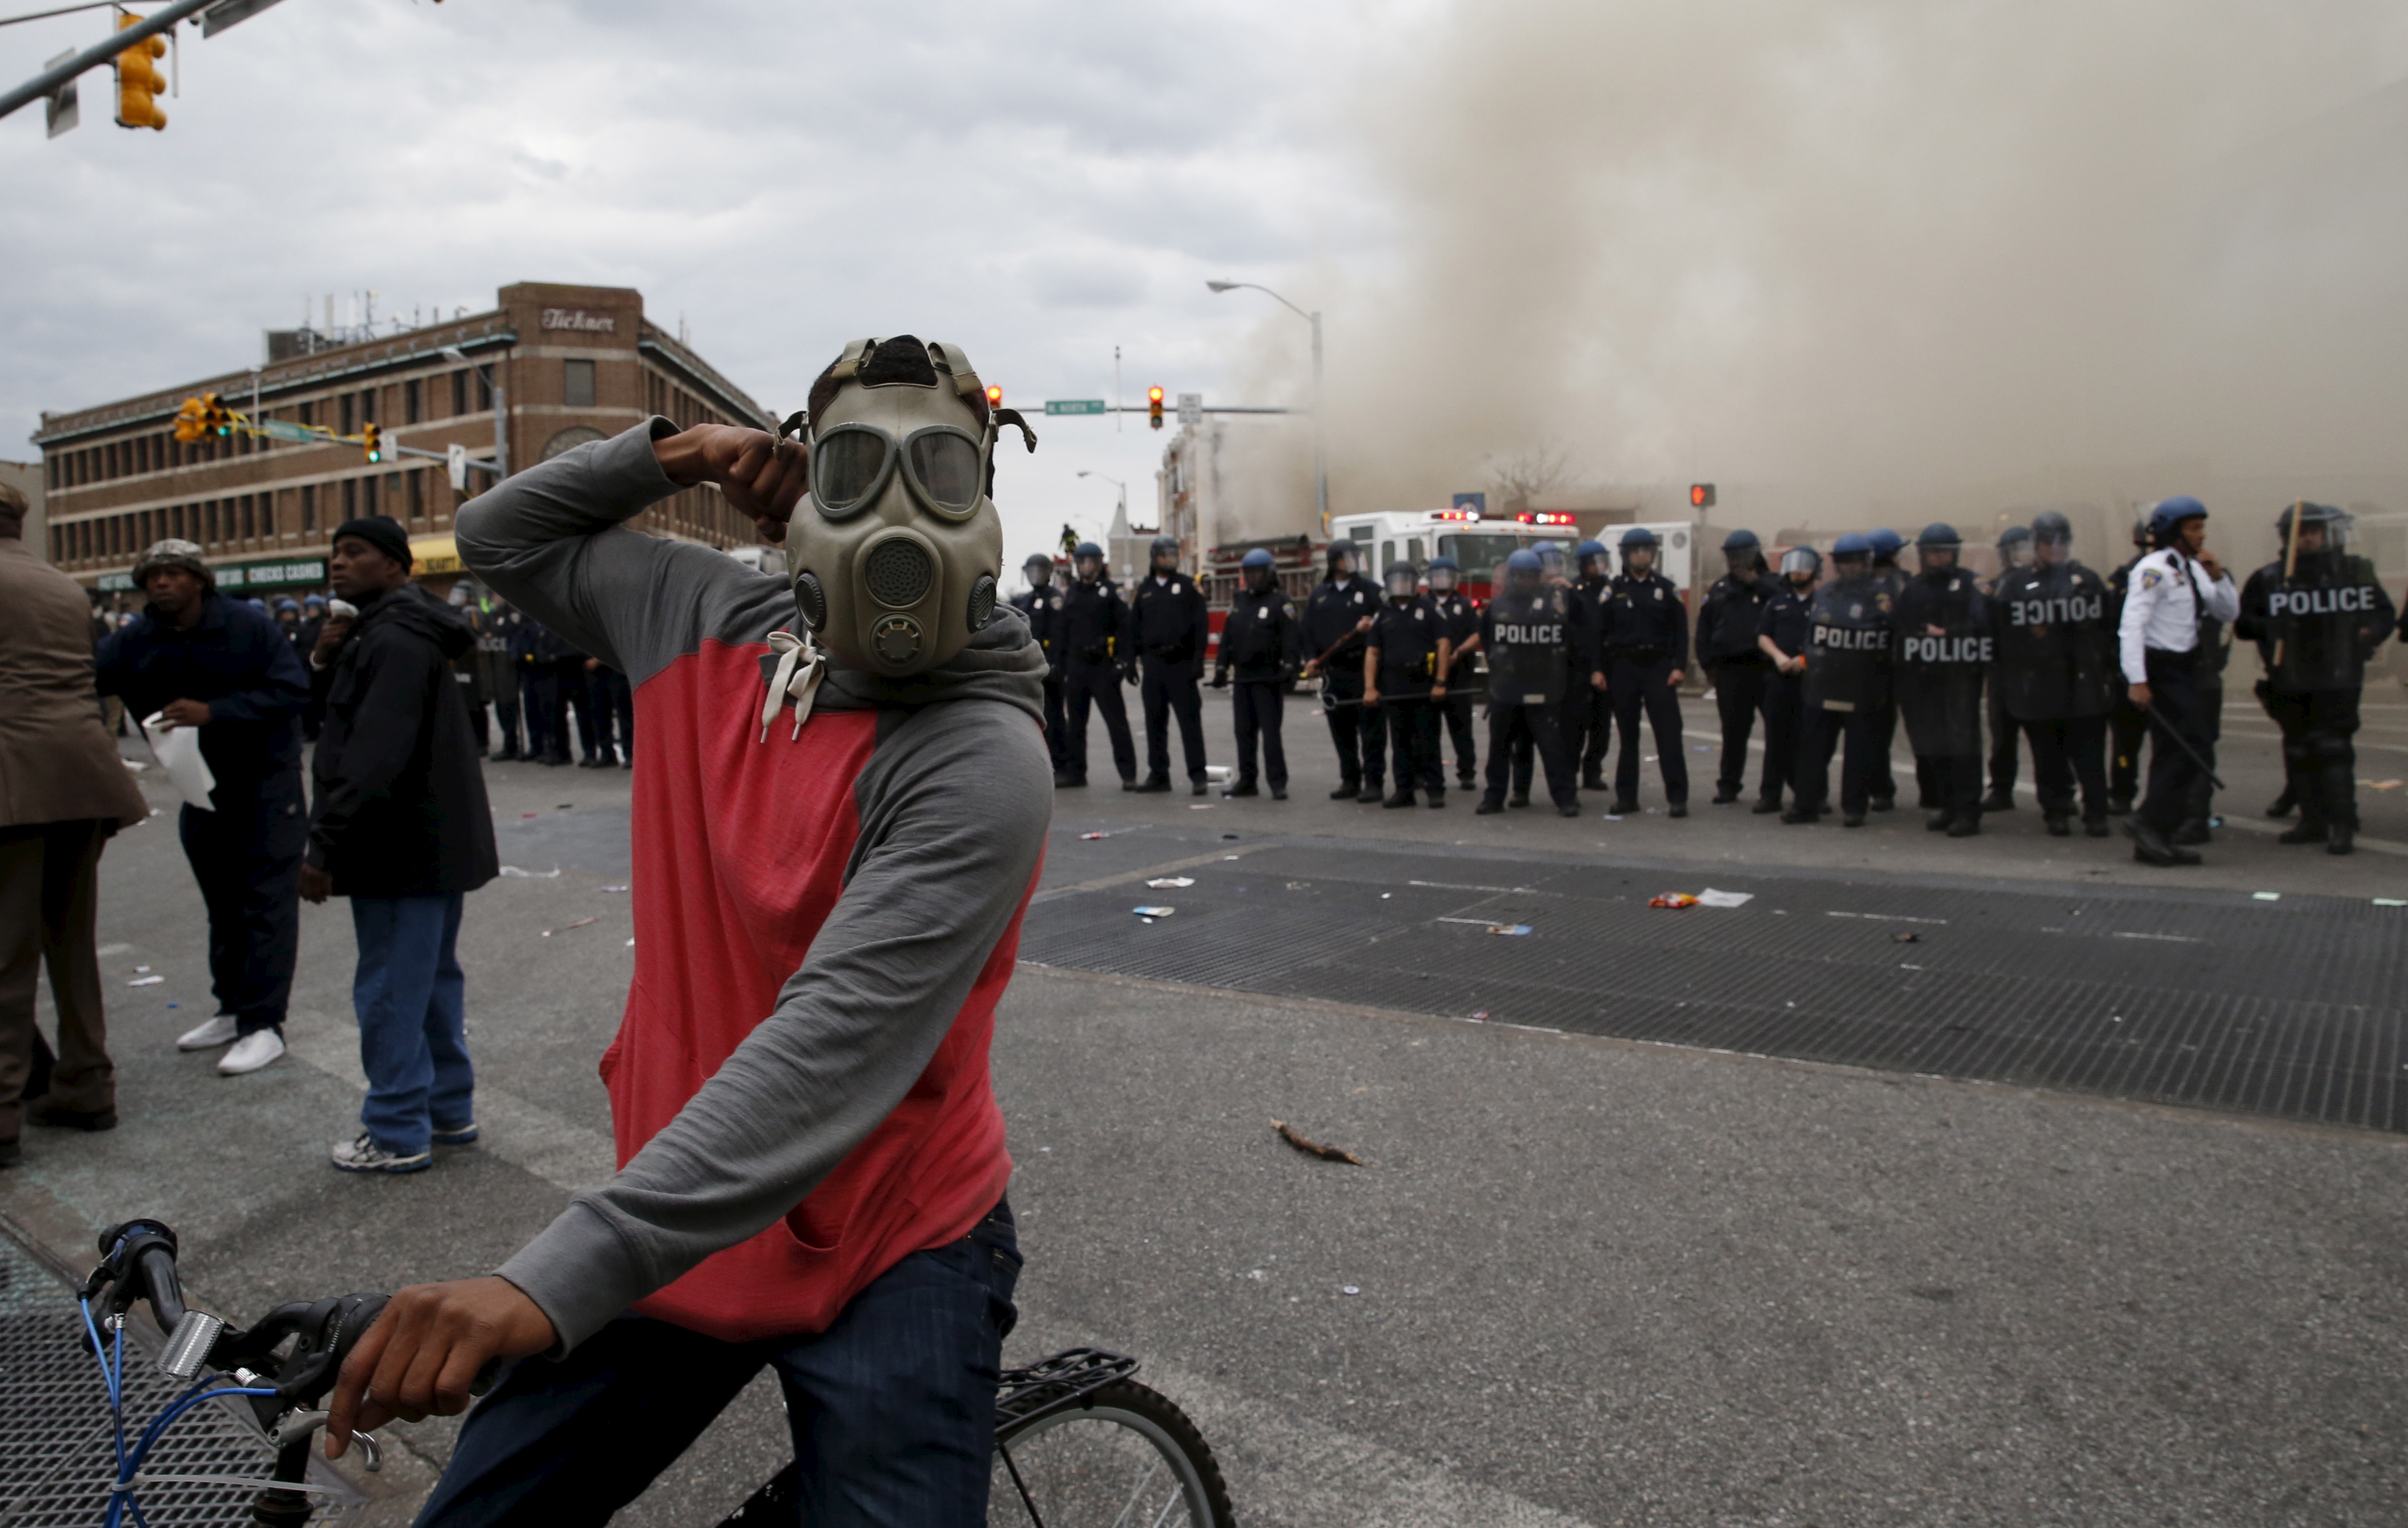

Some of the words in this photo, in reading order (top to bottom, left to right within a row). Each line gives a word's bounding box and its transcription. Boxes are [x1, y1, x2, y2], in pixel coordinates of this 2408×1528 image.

[249, 566, 284, 583] CHECKS
[286, 562, 324, 581] CASHED
[2010, 594, 2102, 626] POLICE
[2269, 585, 2376, 616] POLICE
[1494, 624, 1563, 644] POLICE
[1813, 625, 1890, 649] POLICE
[1905, 636, 1993, 662] POLICE
